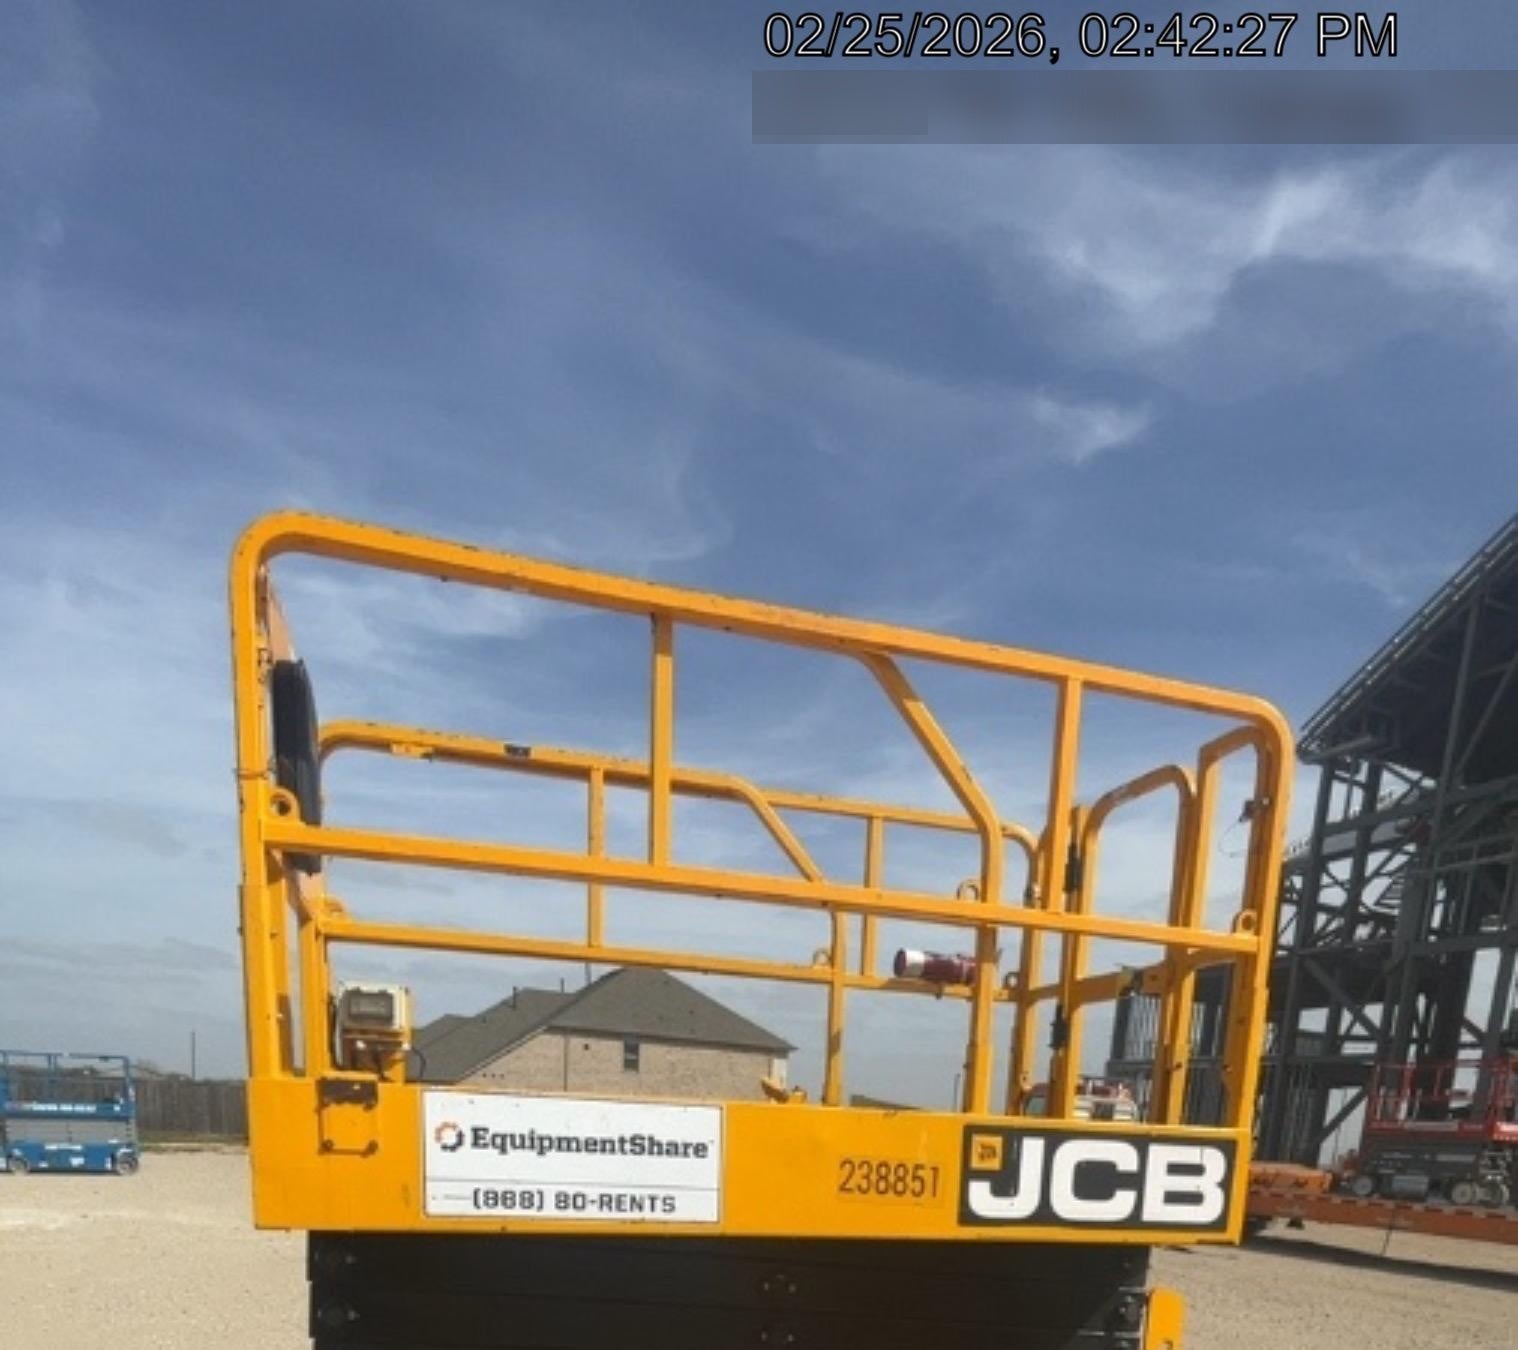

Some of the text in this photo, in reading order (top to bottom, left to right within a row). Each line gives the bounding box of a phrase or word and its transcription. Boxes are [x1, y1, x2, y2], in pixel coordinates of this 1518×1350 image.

[470, 1127, 709, 1158] EquipmentShare
[839, 1158, 940, 1198] 238851
[968, 1136, 1228, 1224] JCB
[554, 1191, 677, 1214] 80-RENTS
